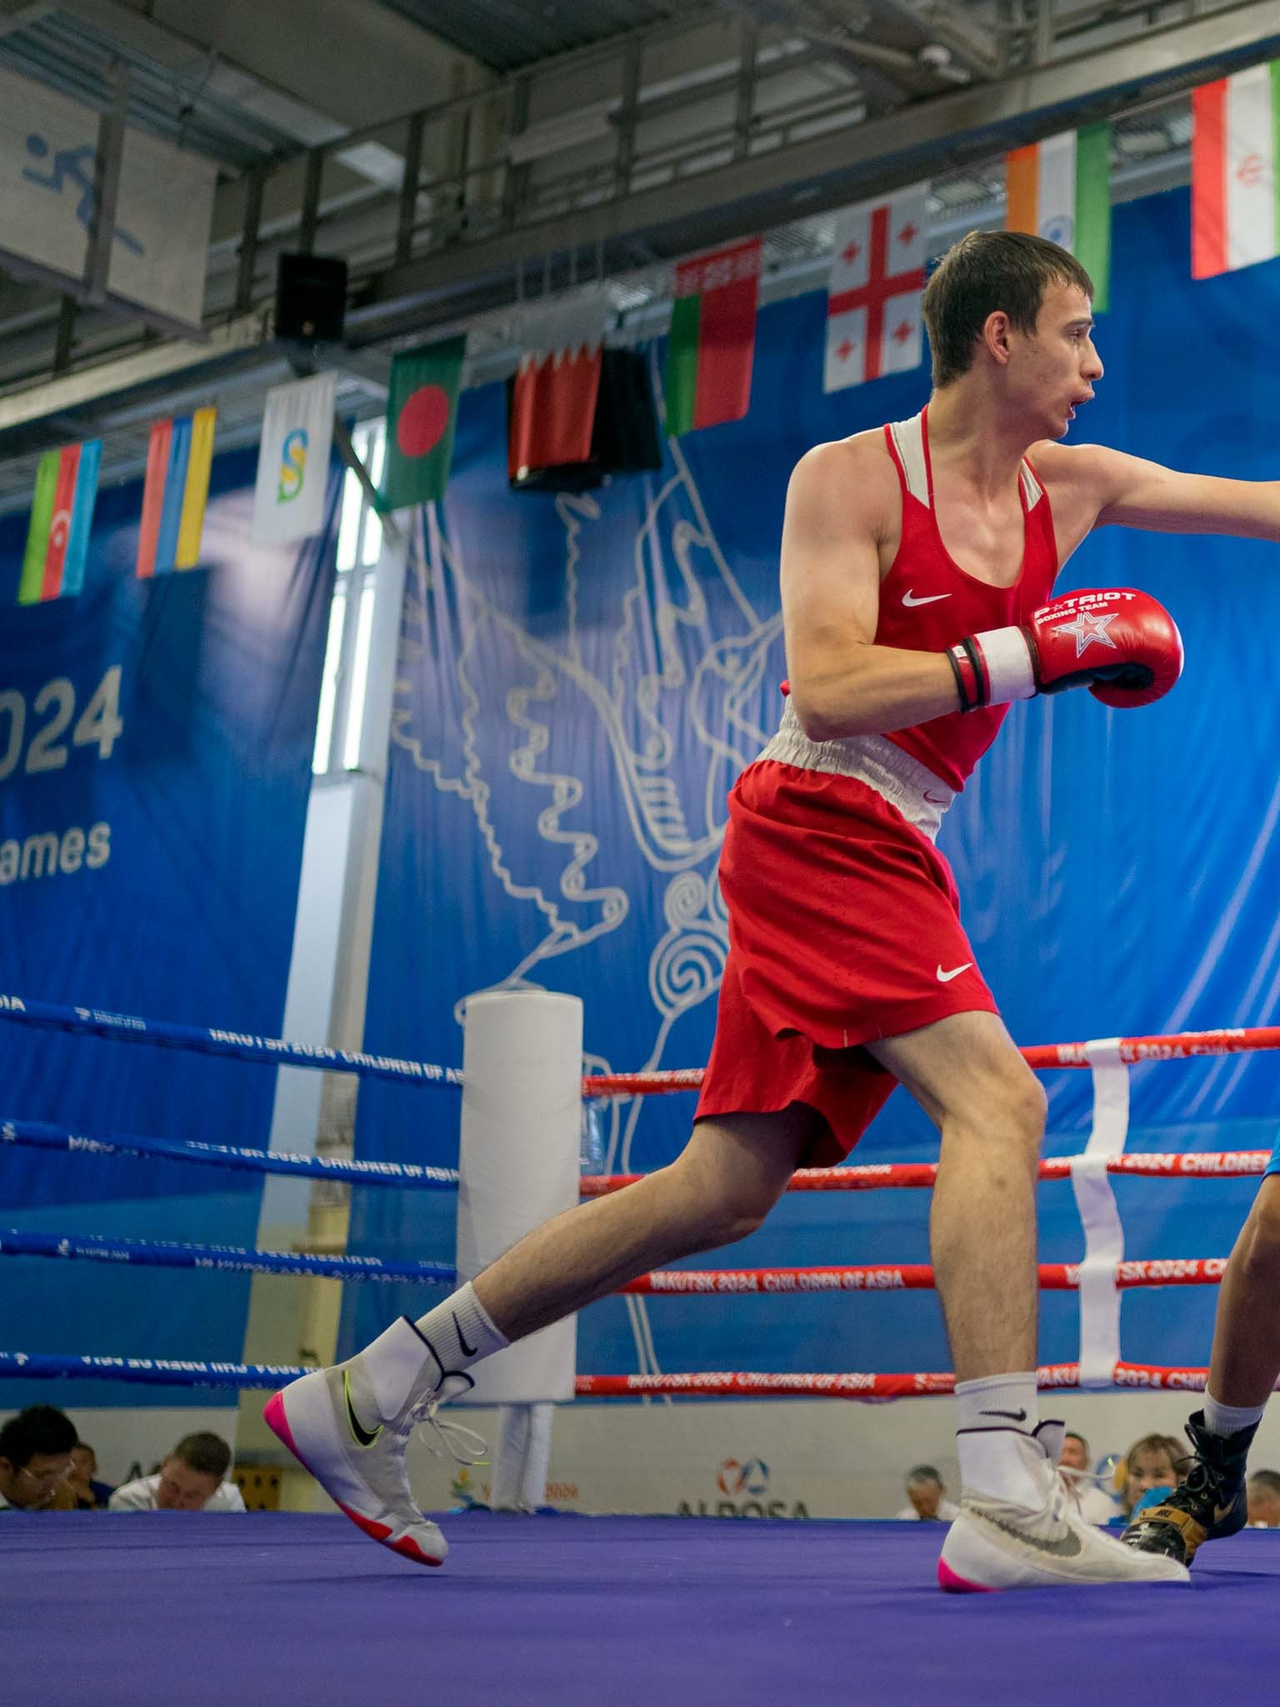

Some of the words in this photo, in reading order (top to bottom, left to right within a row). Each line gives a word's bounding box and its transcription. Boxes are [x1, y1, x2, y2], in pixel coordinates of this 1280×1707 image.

[1037, 608, 1077, 625] BOXING
[1078, 601, 1109, 614] TEAM
[0, 821, 112, 886] ames
